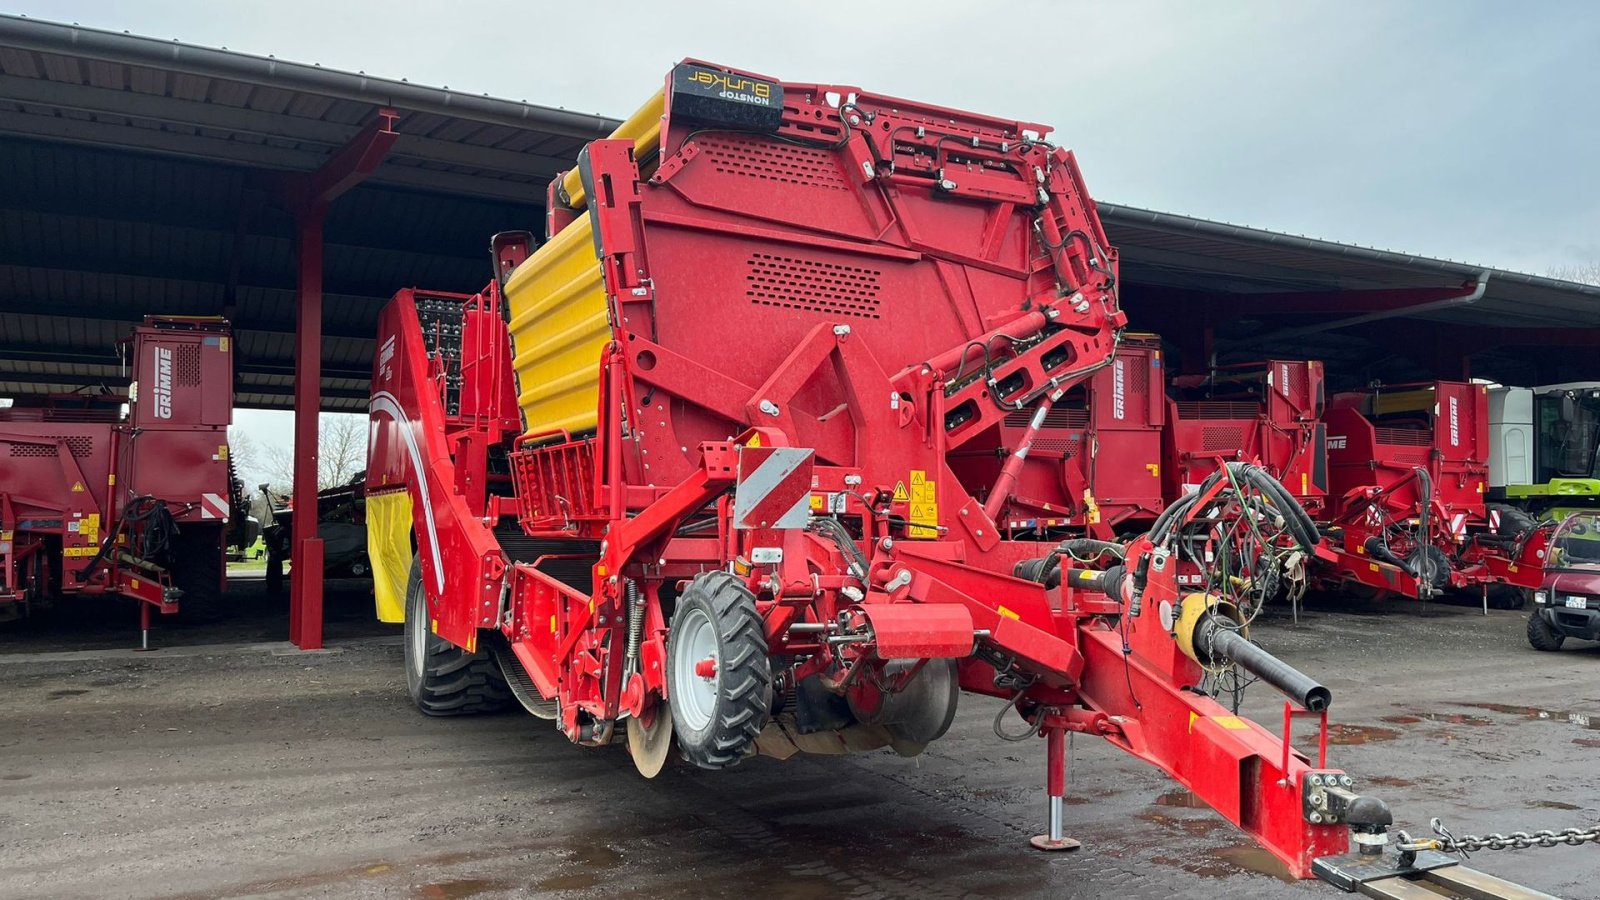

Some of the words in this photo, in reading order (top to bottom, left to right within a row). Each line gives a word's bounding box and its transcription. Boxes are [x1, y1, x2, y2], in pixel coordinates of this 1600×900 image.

[688, 71, 769, 98] Bunker
[719, 90, 769, 105] NONSTOP
[154, 346, 172, 419] GRIMME
[1113, 360, 1124, 420] GRIMME
[1450, 396, 1458, 447] GRIMME
